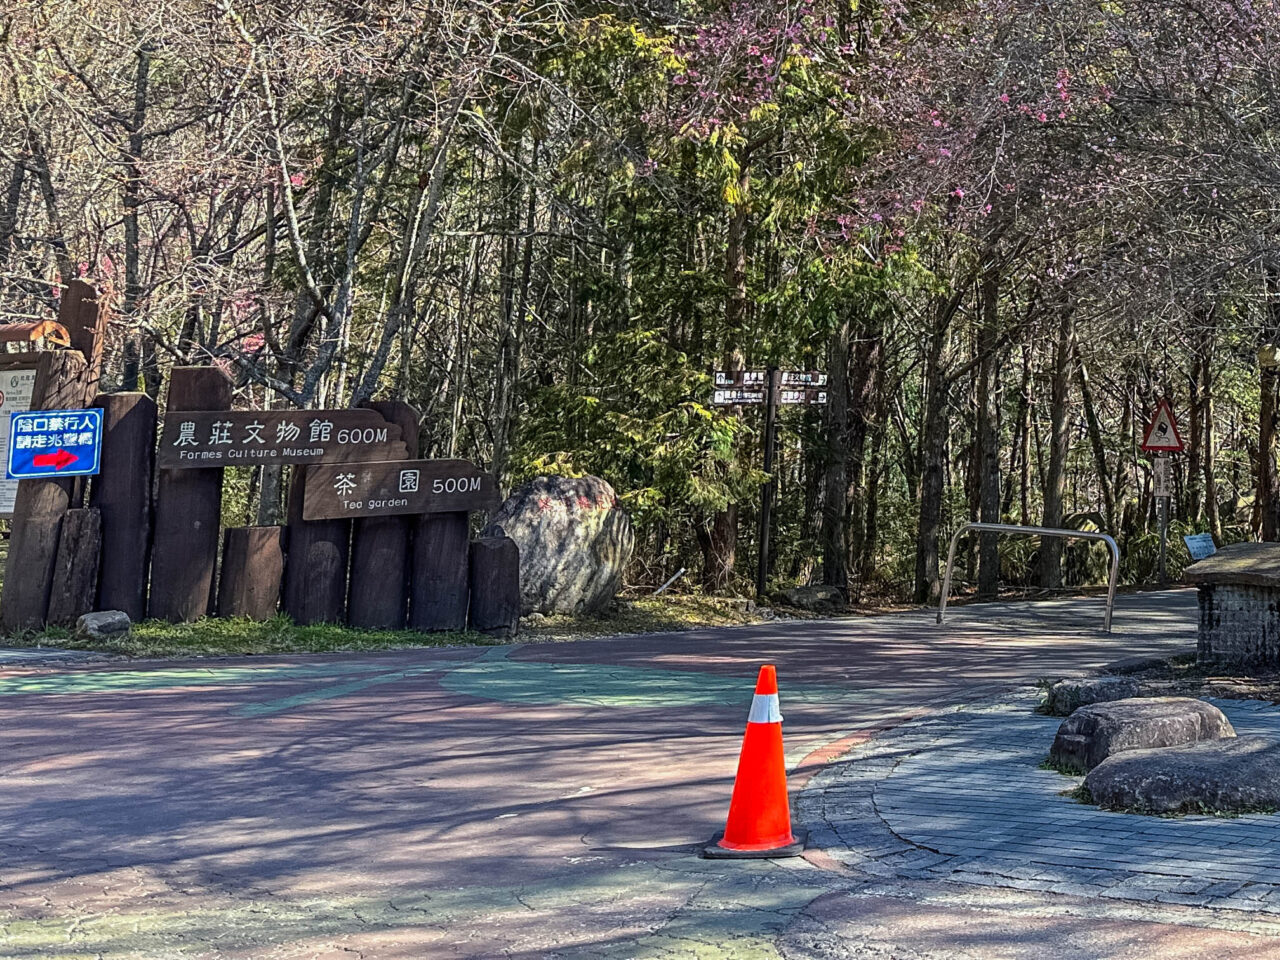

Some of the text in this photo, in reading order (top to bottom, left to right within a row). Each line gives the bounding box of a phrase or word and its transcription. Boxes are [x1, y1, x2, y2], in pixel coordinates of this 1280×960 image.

[173, 419, 388, 447] 農莊文物館 600M
[228, 447, 277, 458] Culture
[282, 446, 324, 457] Museum
[333, 470, 482, 497] 茶園 500M
[343, 498, 408, 510] Tea garden
